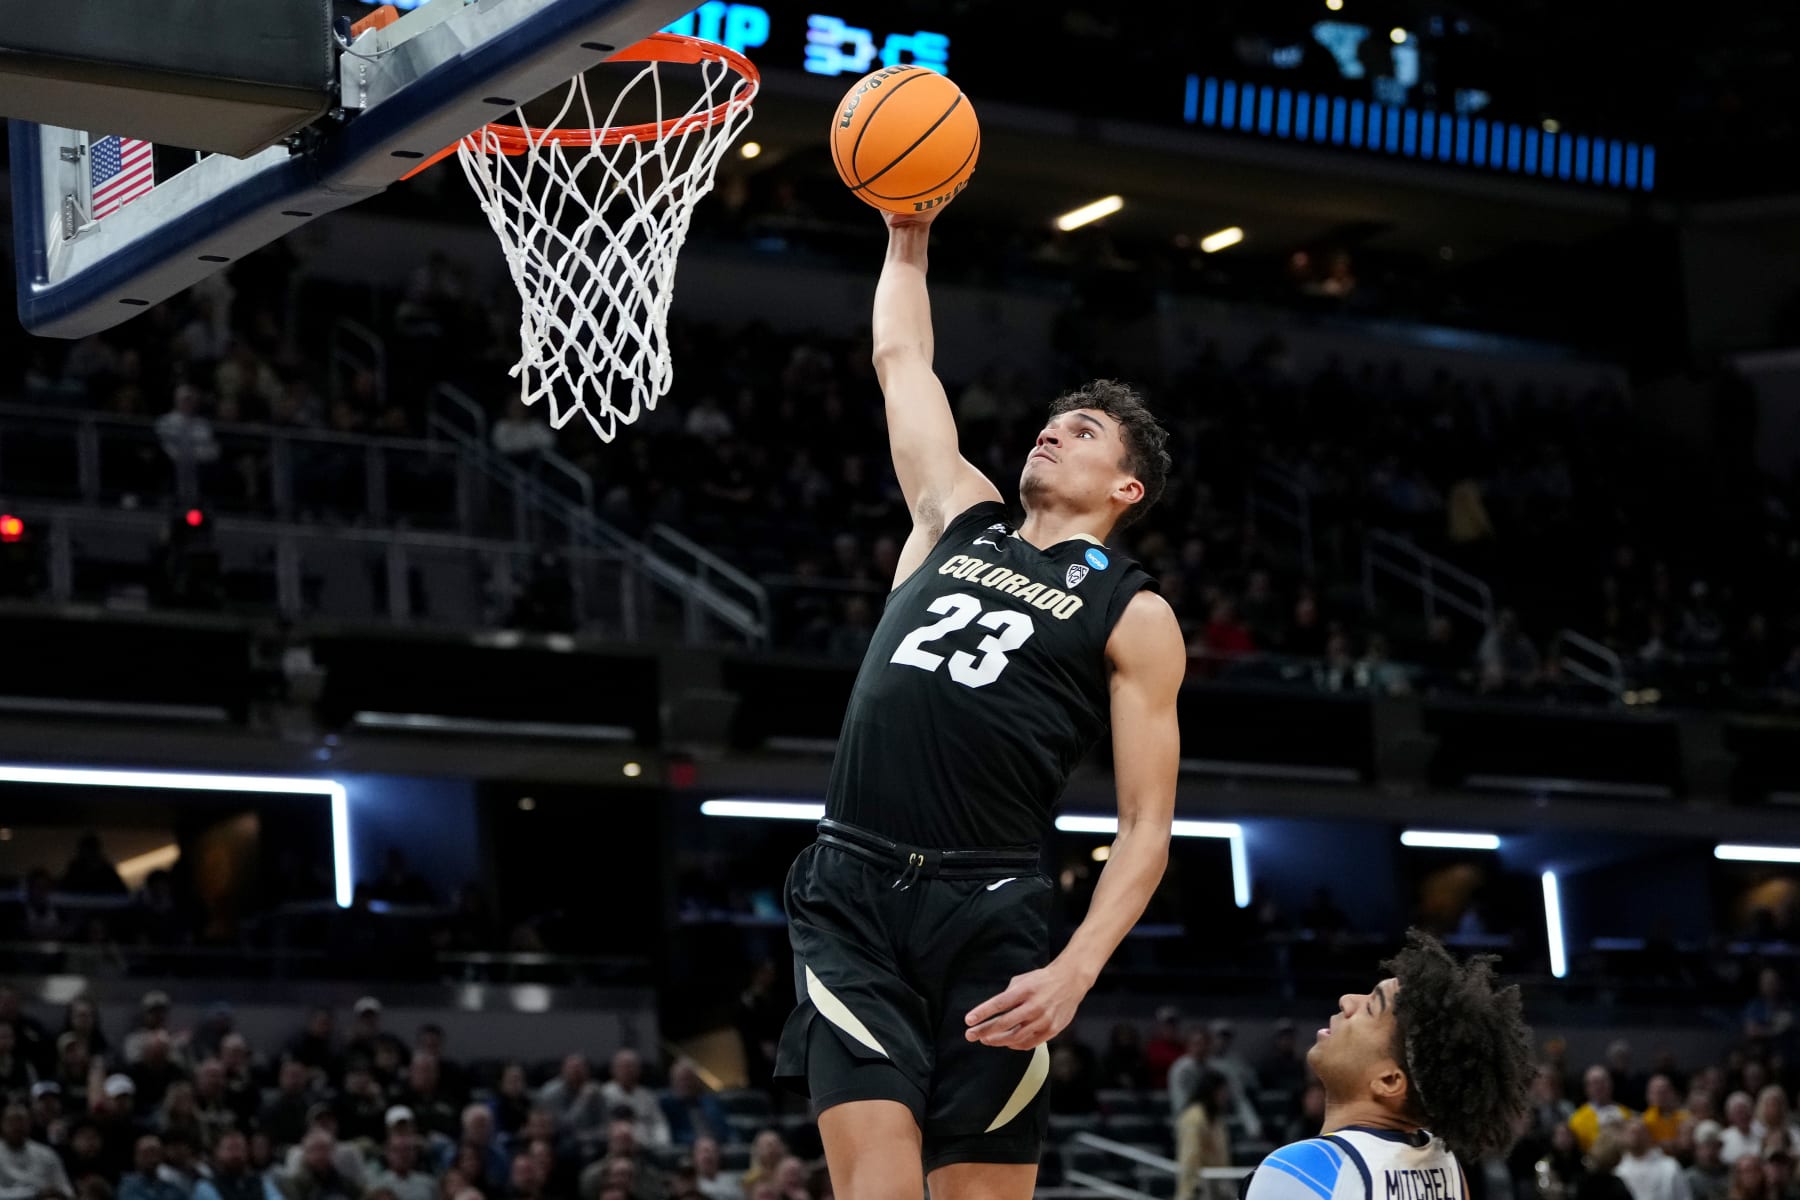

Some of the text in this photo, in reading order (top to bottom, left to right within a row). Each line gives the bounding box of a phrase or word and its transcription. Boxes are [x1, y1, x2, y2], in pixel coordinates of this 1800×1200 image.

[938, 555, 1083, 620] COLORADO
[890, 593, 1034, 688] 23
[1385, 1167, 1456, 1200] MITCHEL
